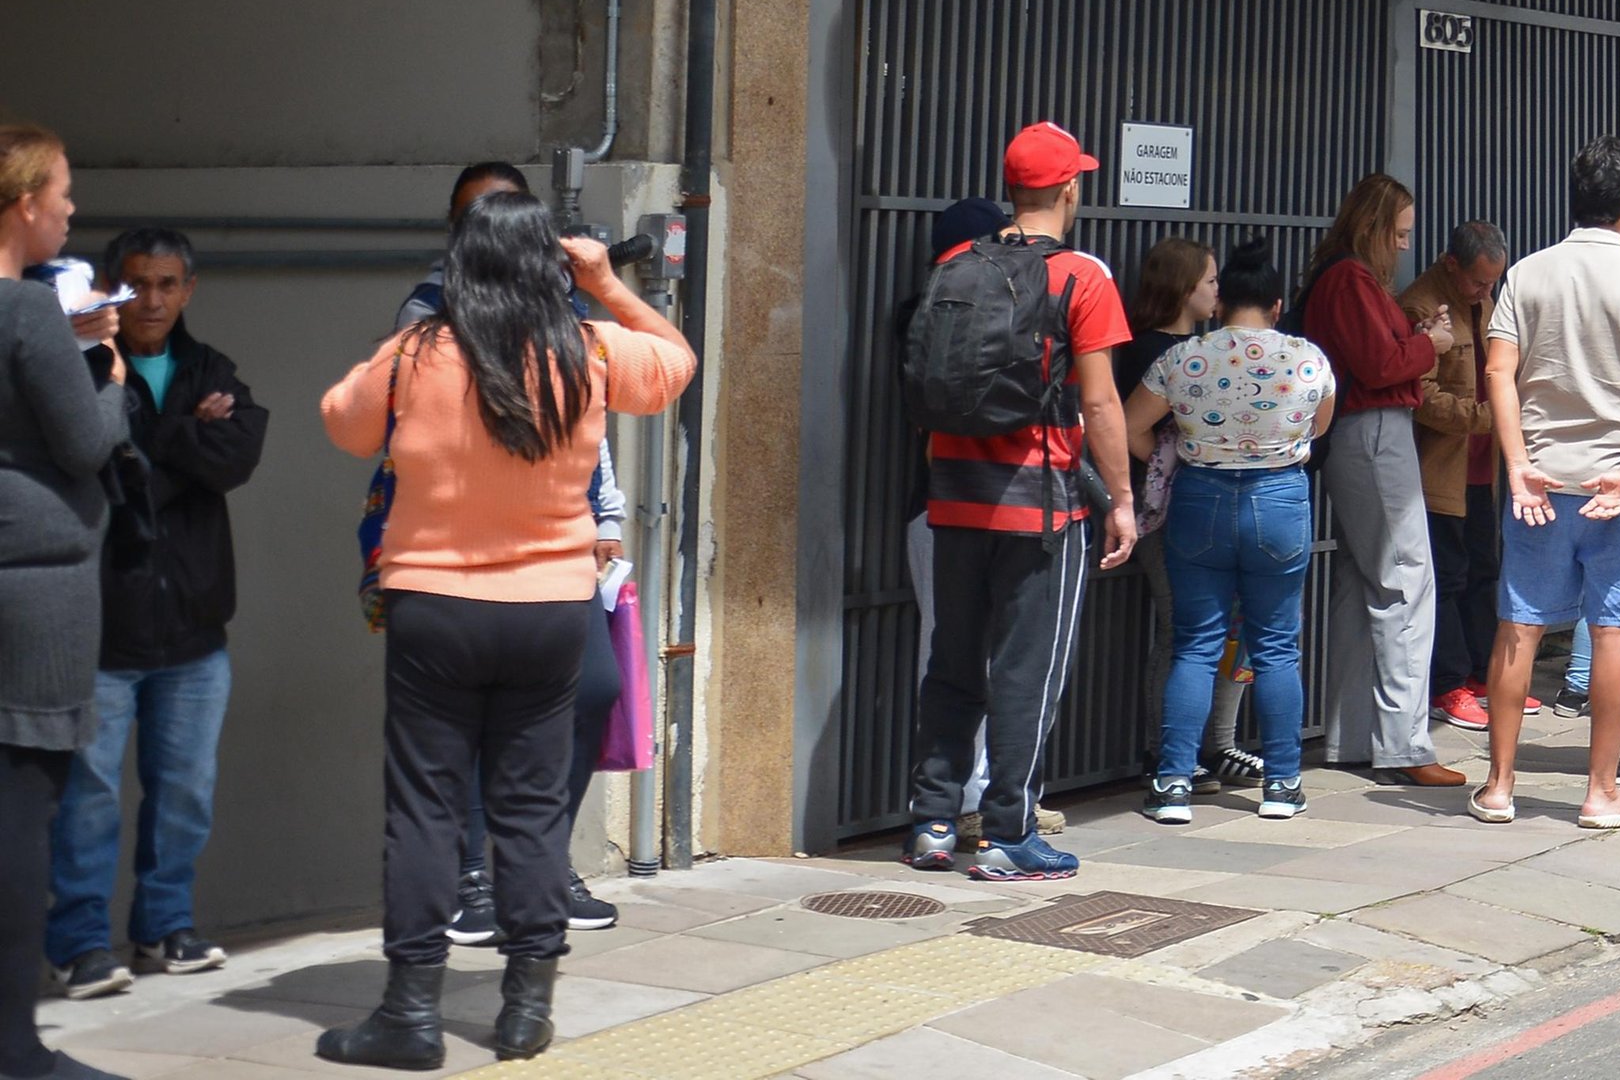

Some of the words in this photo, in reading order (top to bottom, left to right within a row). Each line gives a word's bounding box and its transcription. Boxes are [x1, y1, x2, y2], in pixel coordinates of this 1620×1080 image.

[1424, 12, 1473, 48] 805
[1136, 144, 1178, 159] GARAGEM
[1123, 168, 1143, 184] NÃO
[1144, 171, 1188, 187] ESTACIONE
